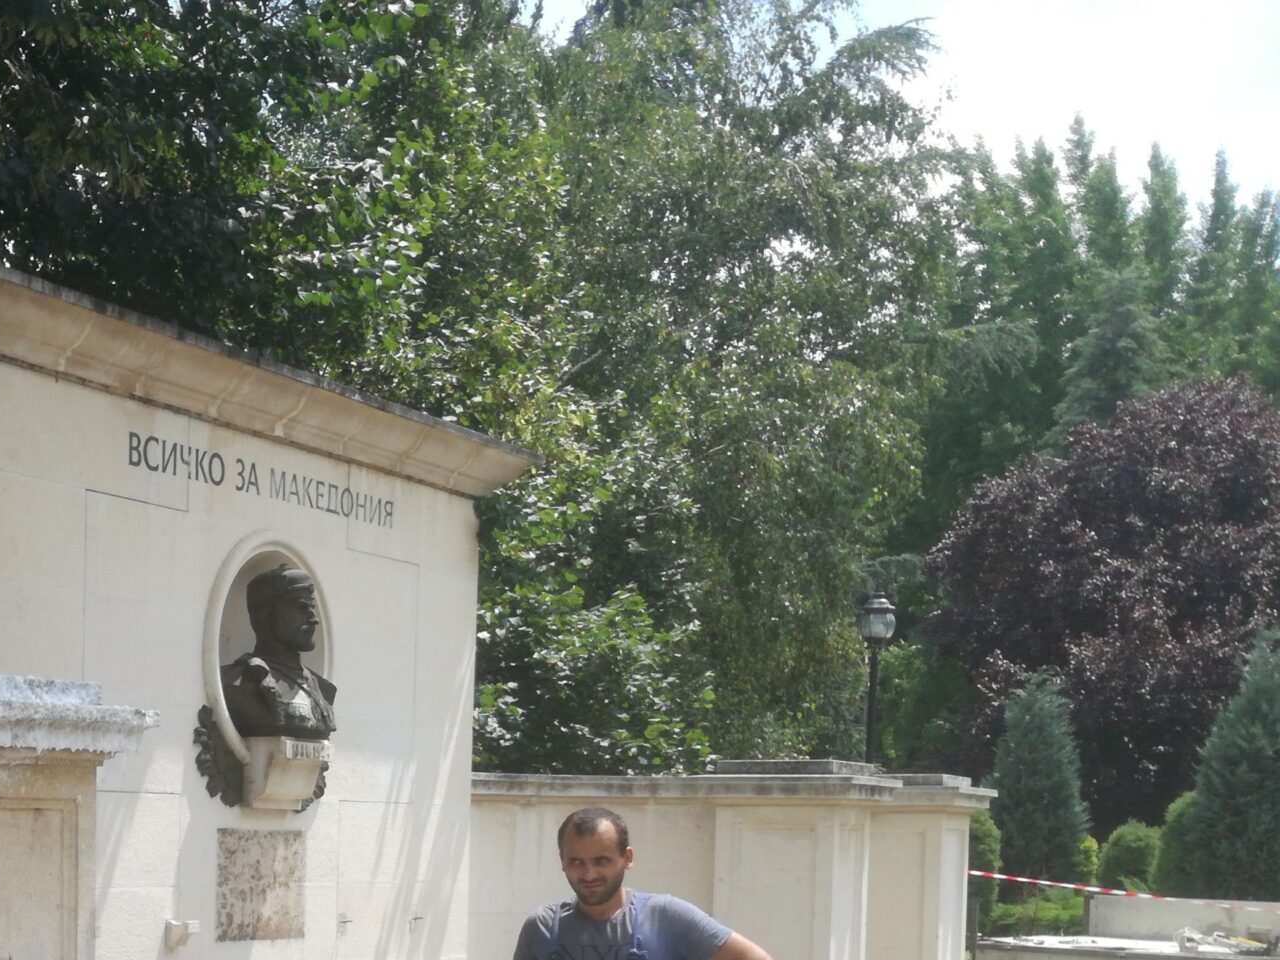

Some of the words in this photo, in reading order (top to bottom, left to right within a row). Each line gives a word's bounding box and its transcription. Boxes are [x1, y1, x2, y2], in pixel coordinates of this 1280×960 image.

[128, 431, 225, 486] ВСИЧКО
[235, 458, 260, 496] ЗА
[270, 467, 394, 529] МАКЕДОНИЯ
